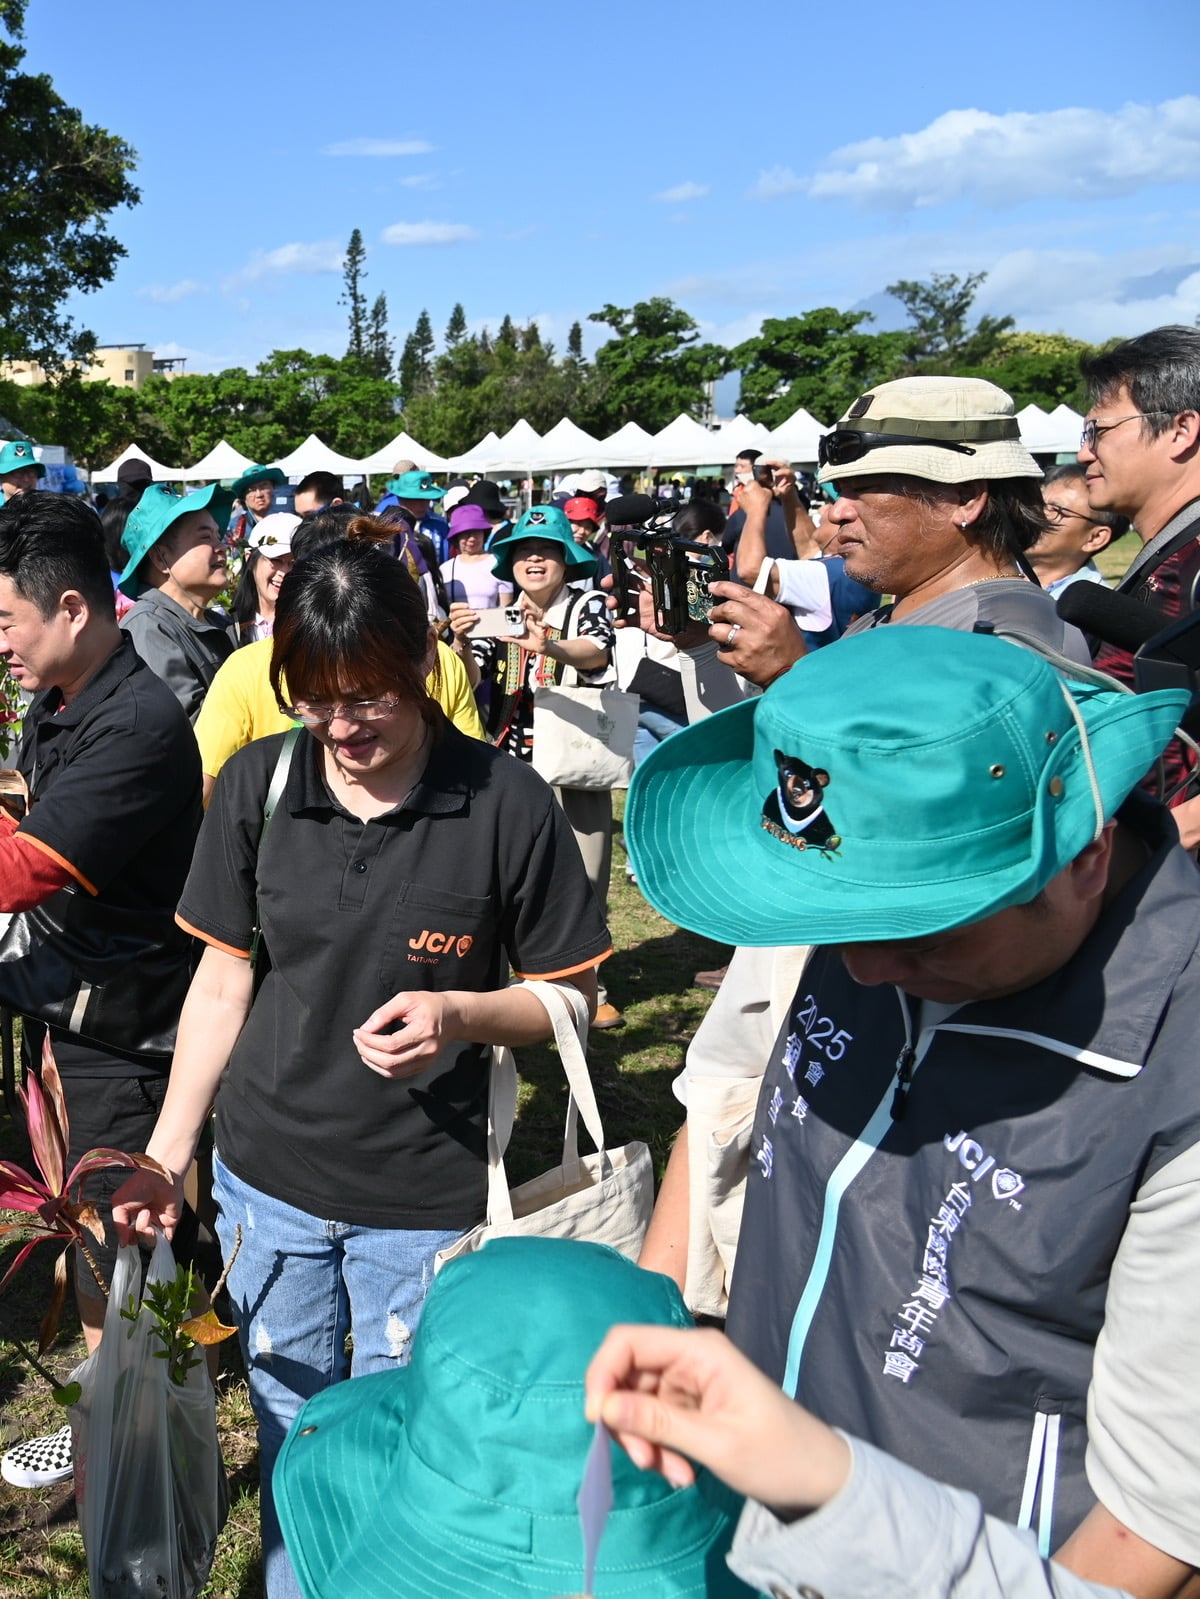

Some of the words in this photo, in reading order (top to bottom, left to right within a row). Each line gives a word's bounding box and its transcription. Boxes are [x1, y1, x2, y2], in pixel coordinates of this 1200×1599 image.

[407, 953, 439, 965] TAITUNG
[408, 929, 456, 953] JCI
[796, 995, 853, 1061] 2025
[943, 1129, 996, 1182] JCI
